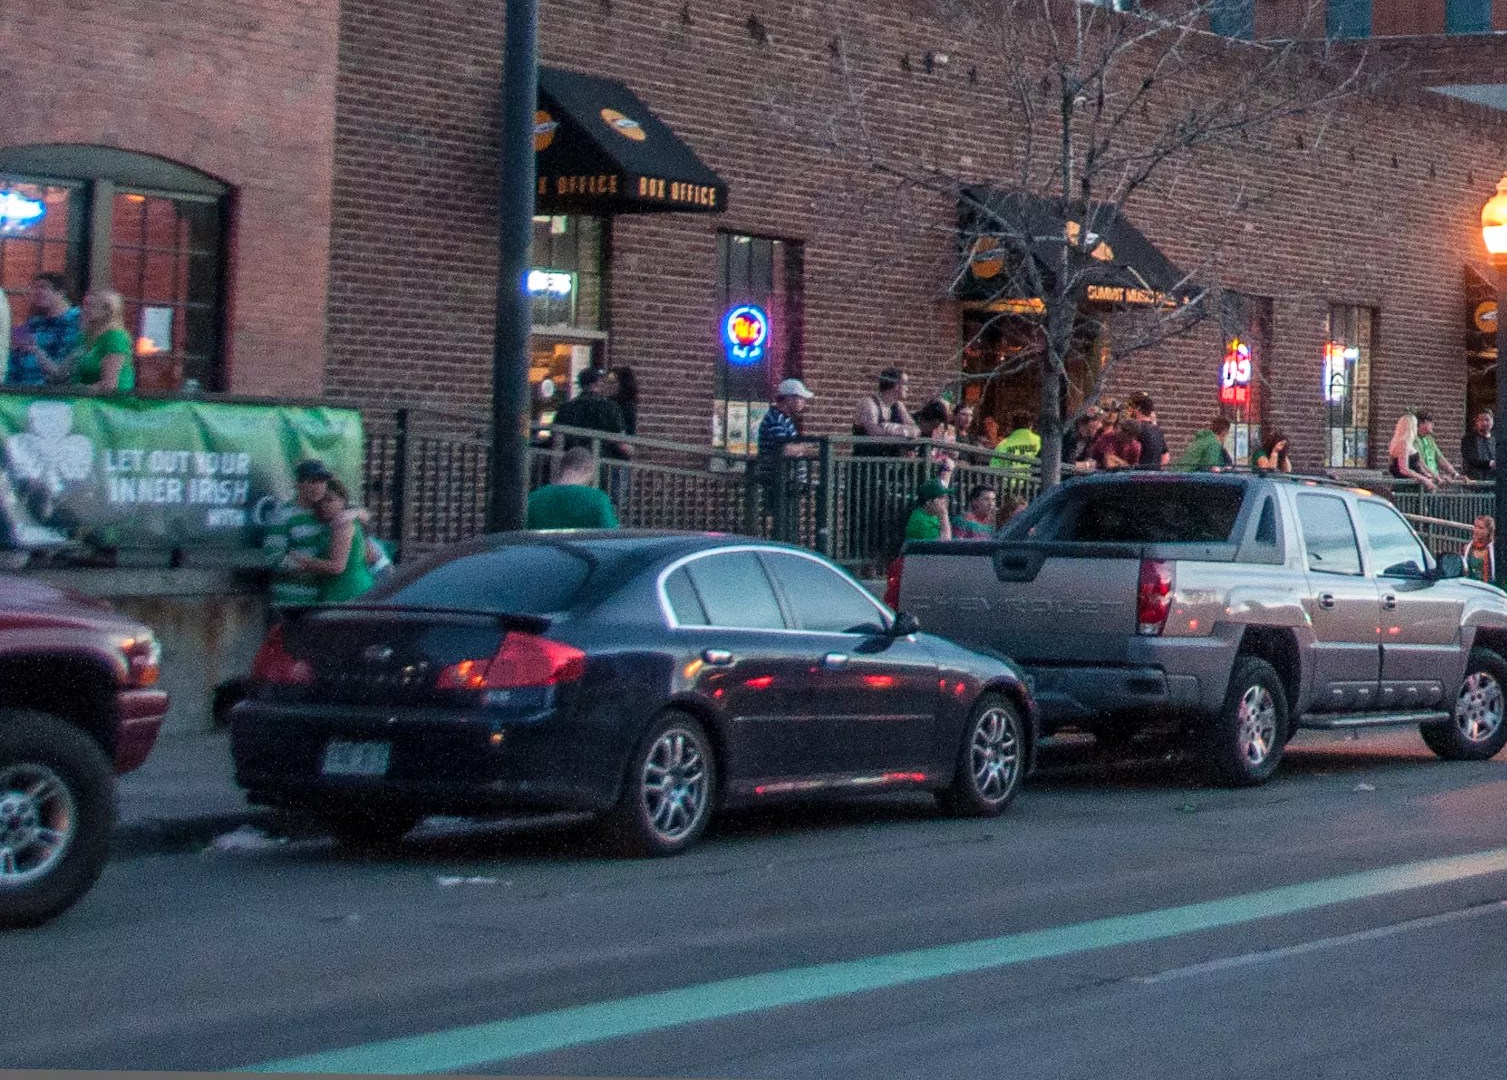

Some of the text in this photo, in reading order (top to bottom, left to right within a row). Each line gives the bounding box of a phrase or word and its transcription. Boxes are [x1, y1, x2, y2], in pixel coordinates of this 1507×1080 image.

[557, 174, 618, 195] OFFICE
[639, 176, 716, 207] BOX OFFICE
[1086, 284, 1124, 301] SUMMIT
[105, 450, 249, 474] LET OUT YOUR
[108, 478, 249, 503] INNER IRISH
